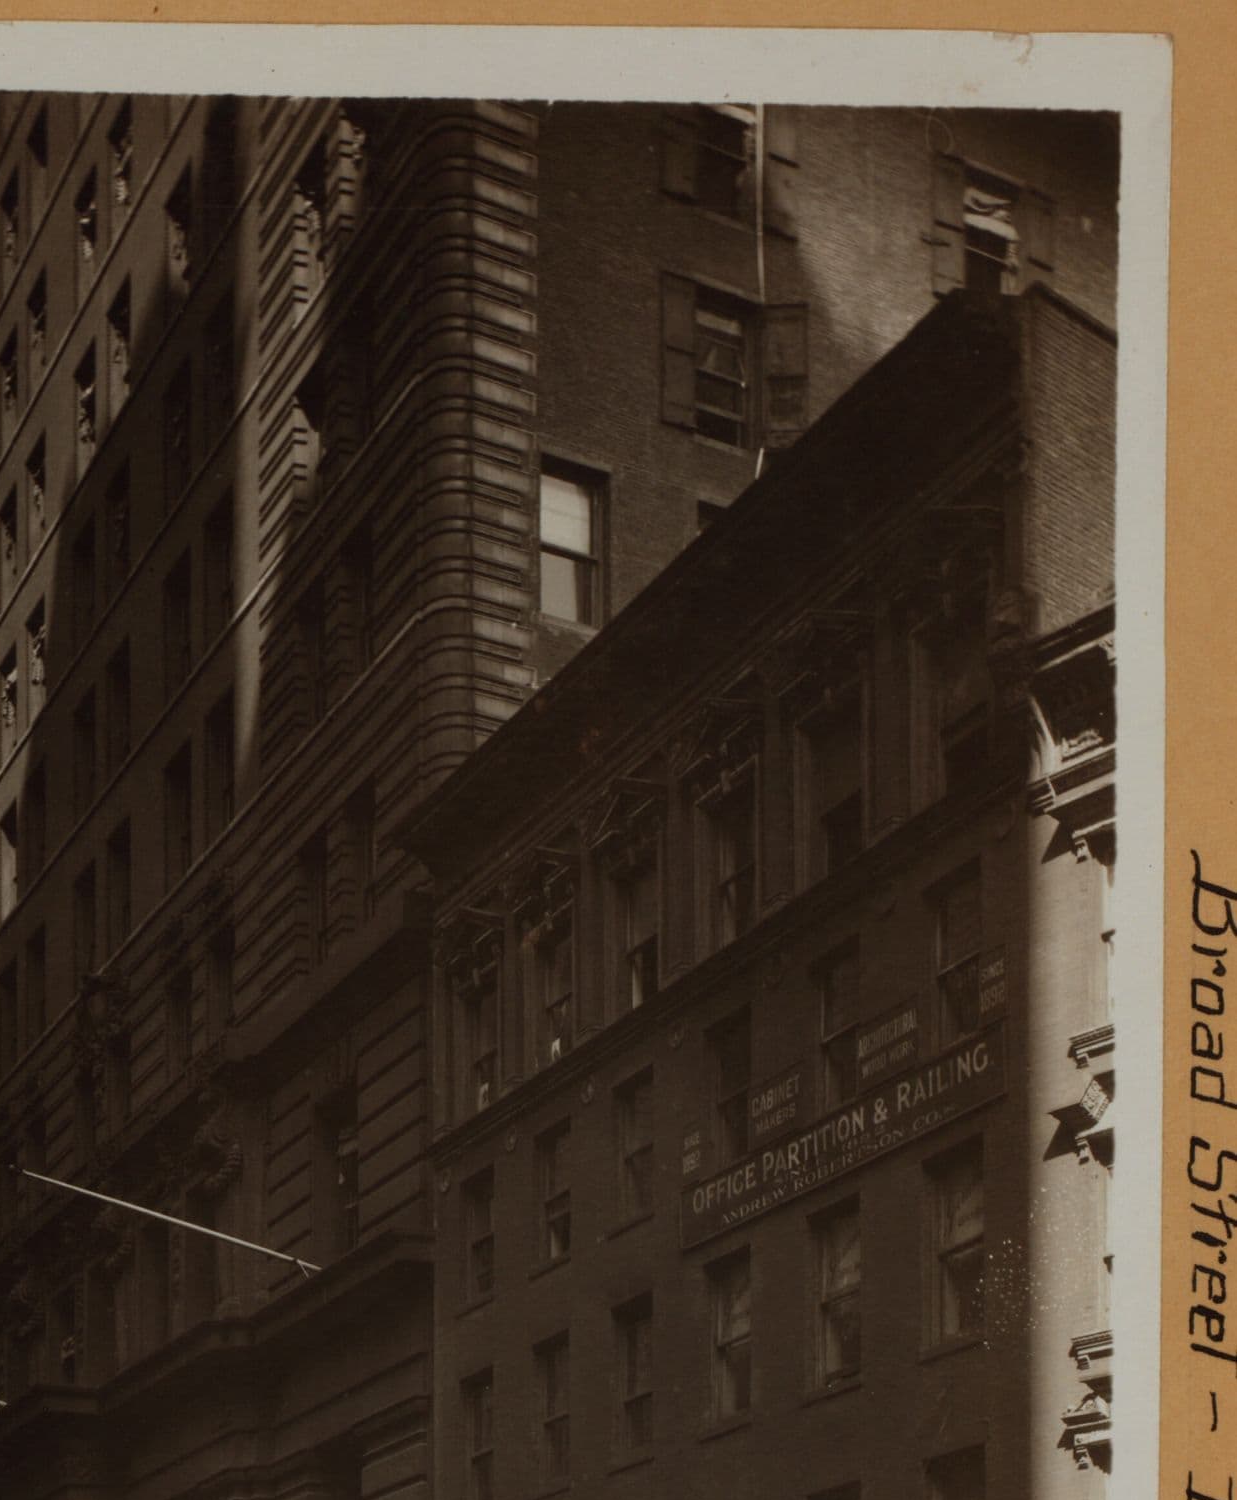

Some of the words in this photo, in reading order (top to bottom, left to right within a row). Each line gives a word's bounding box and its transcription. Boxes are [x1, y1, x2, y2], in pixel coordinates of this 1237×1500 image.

[1191, 850, 1237, 1110] Broad
[692, 1162, 756, 1215] OFFICE
[762, 1105, 865, 1183] PARTITION
[873, 1097, 888, 1125] &
[896, 1041, 988, 1113] RAILING
[751, 1072, 800, 1118] CABINET
[754, 1102, 796, 1136] MAKERS
[720, 1184, 786, 1226] ANDREW
[794, 1128, 904, 1192] ROBERTSON
[1187, 1136, 1237, 1365] Street
